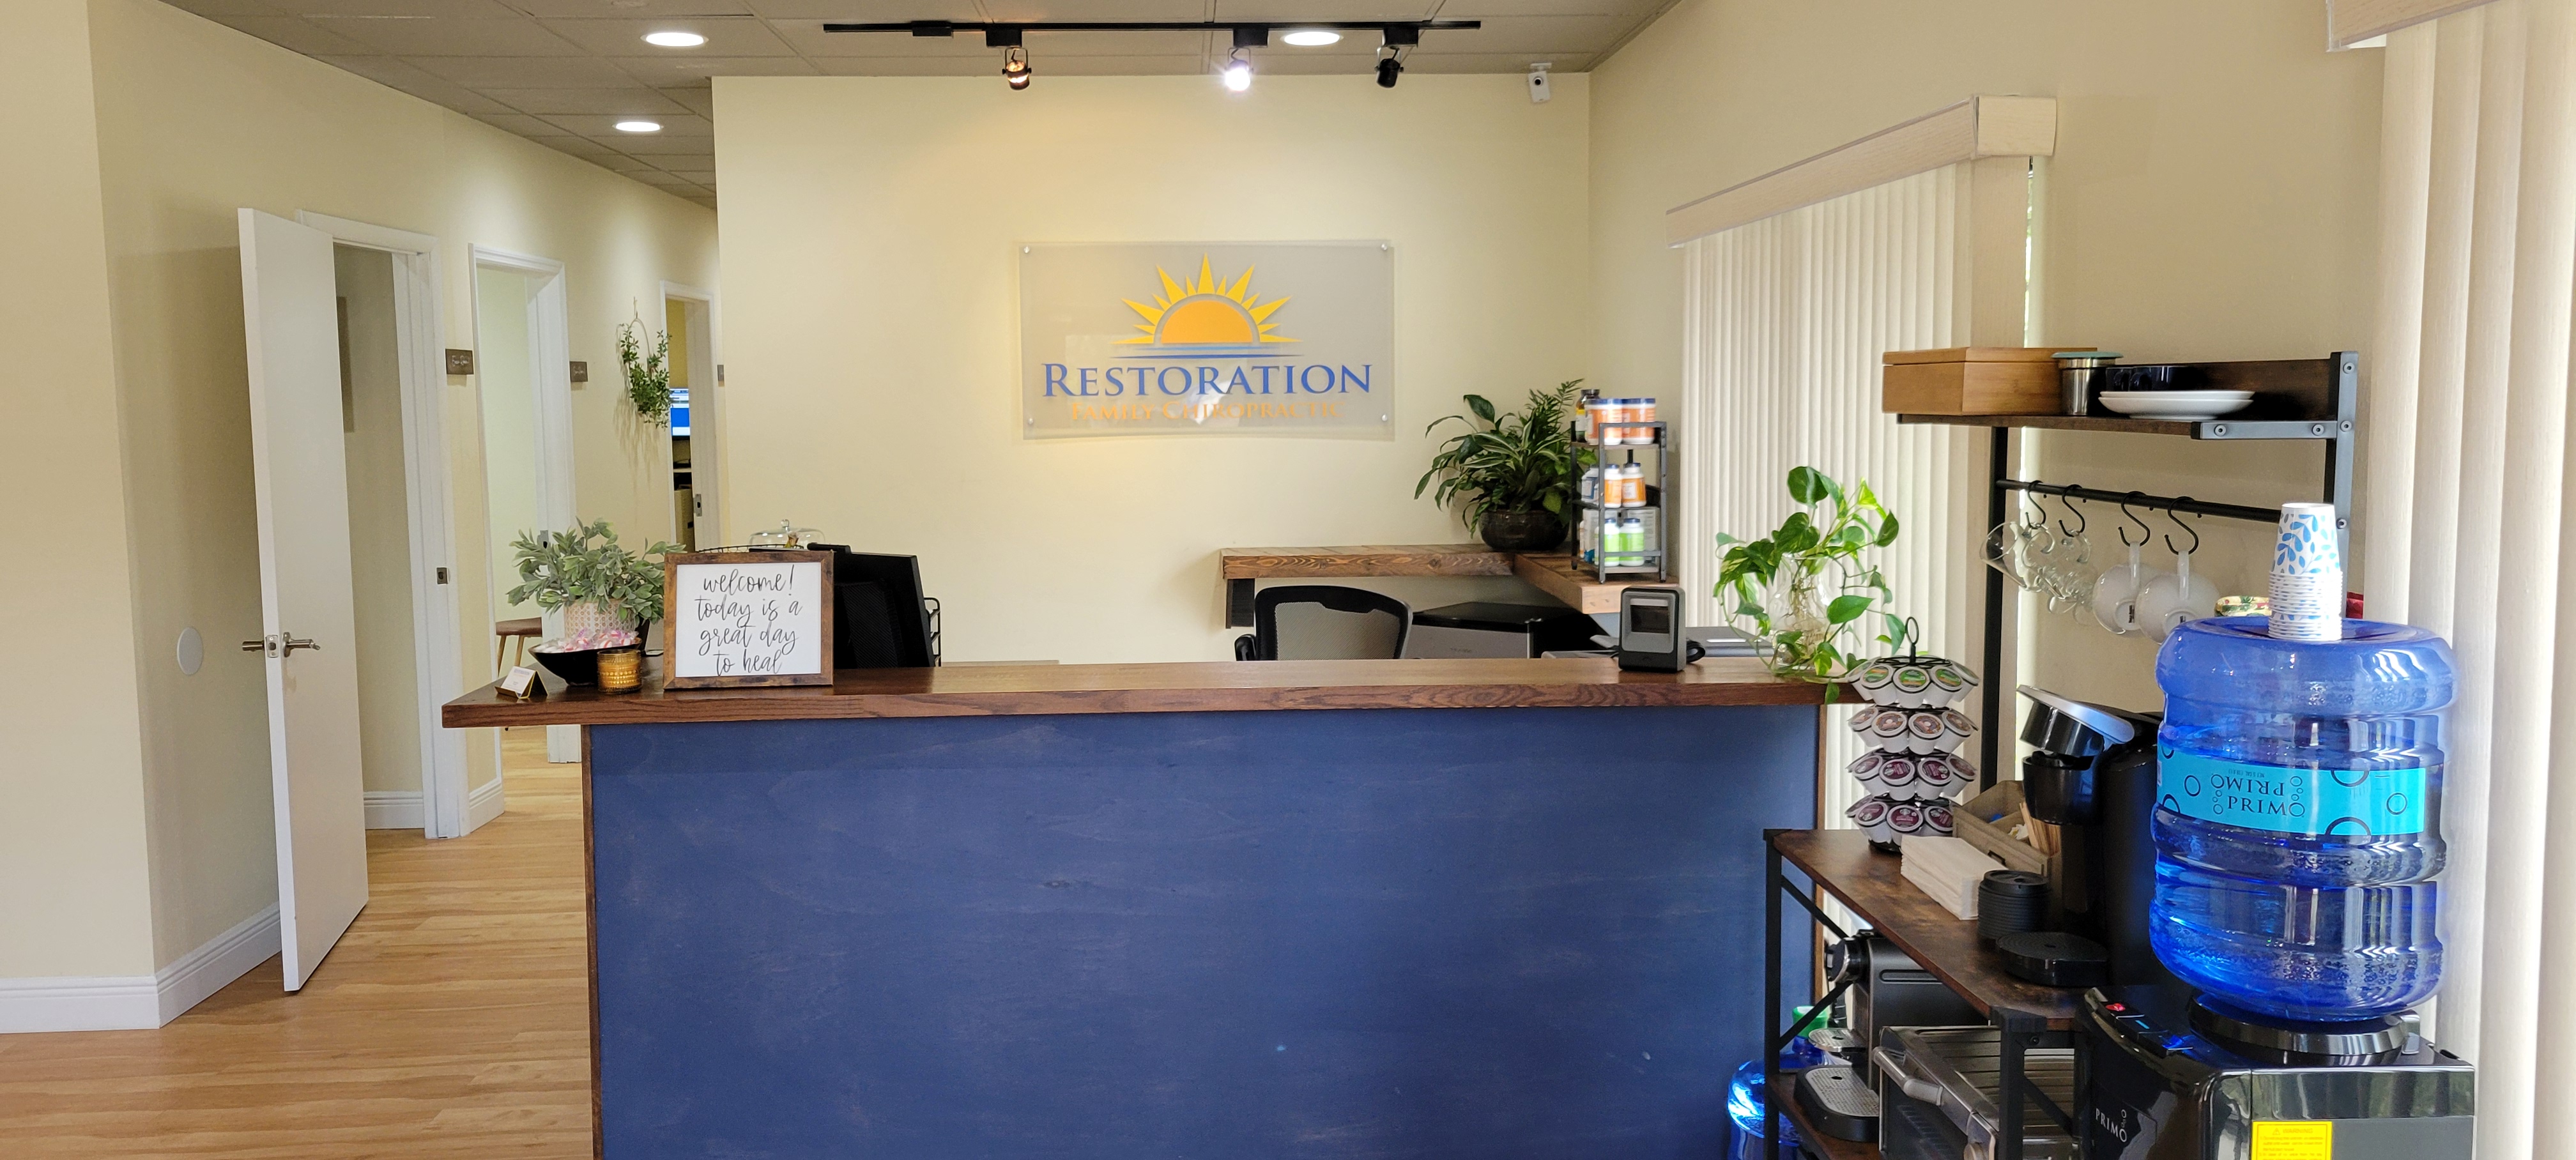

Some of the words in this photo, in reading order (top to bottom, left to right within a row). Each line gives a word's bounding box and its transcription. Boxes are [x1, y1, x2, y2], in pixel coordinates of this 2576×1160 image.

[1041, 363, 1372, 397] RESTORATION
[1071, 402, 1154, 420] FAMILY
[703, 564, 795, 595] welcome!
[694, 594, 754, 628] today
[762, 599, 778, 622] is
[789, 600, 802, 616] a
[698, 625, 756, 656] great
[760, 620, 800, 655] day
[713, 650, 735, 676] to
[743, 648, 783, 674] heal
[2211, 774, 2285, 797] PRIMO
[2228, 795, 2305, 817] PRIMO
[2096, 1108, 2127, 1142] PRIMO
